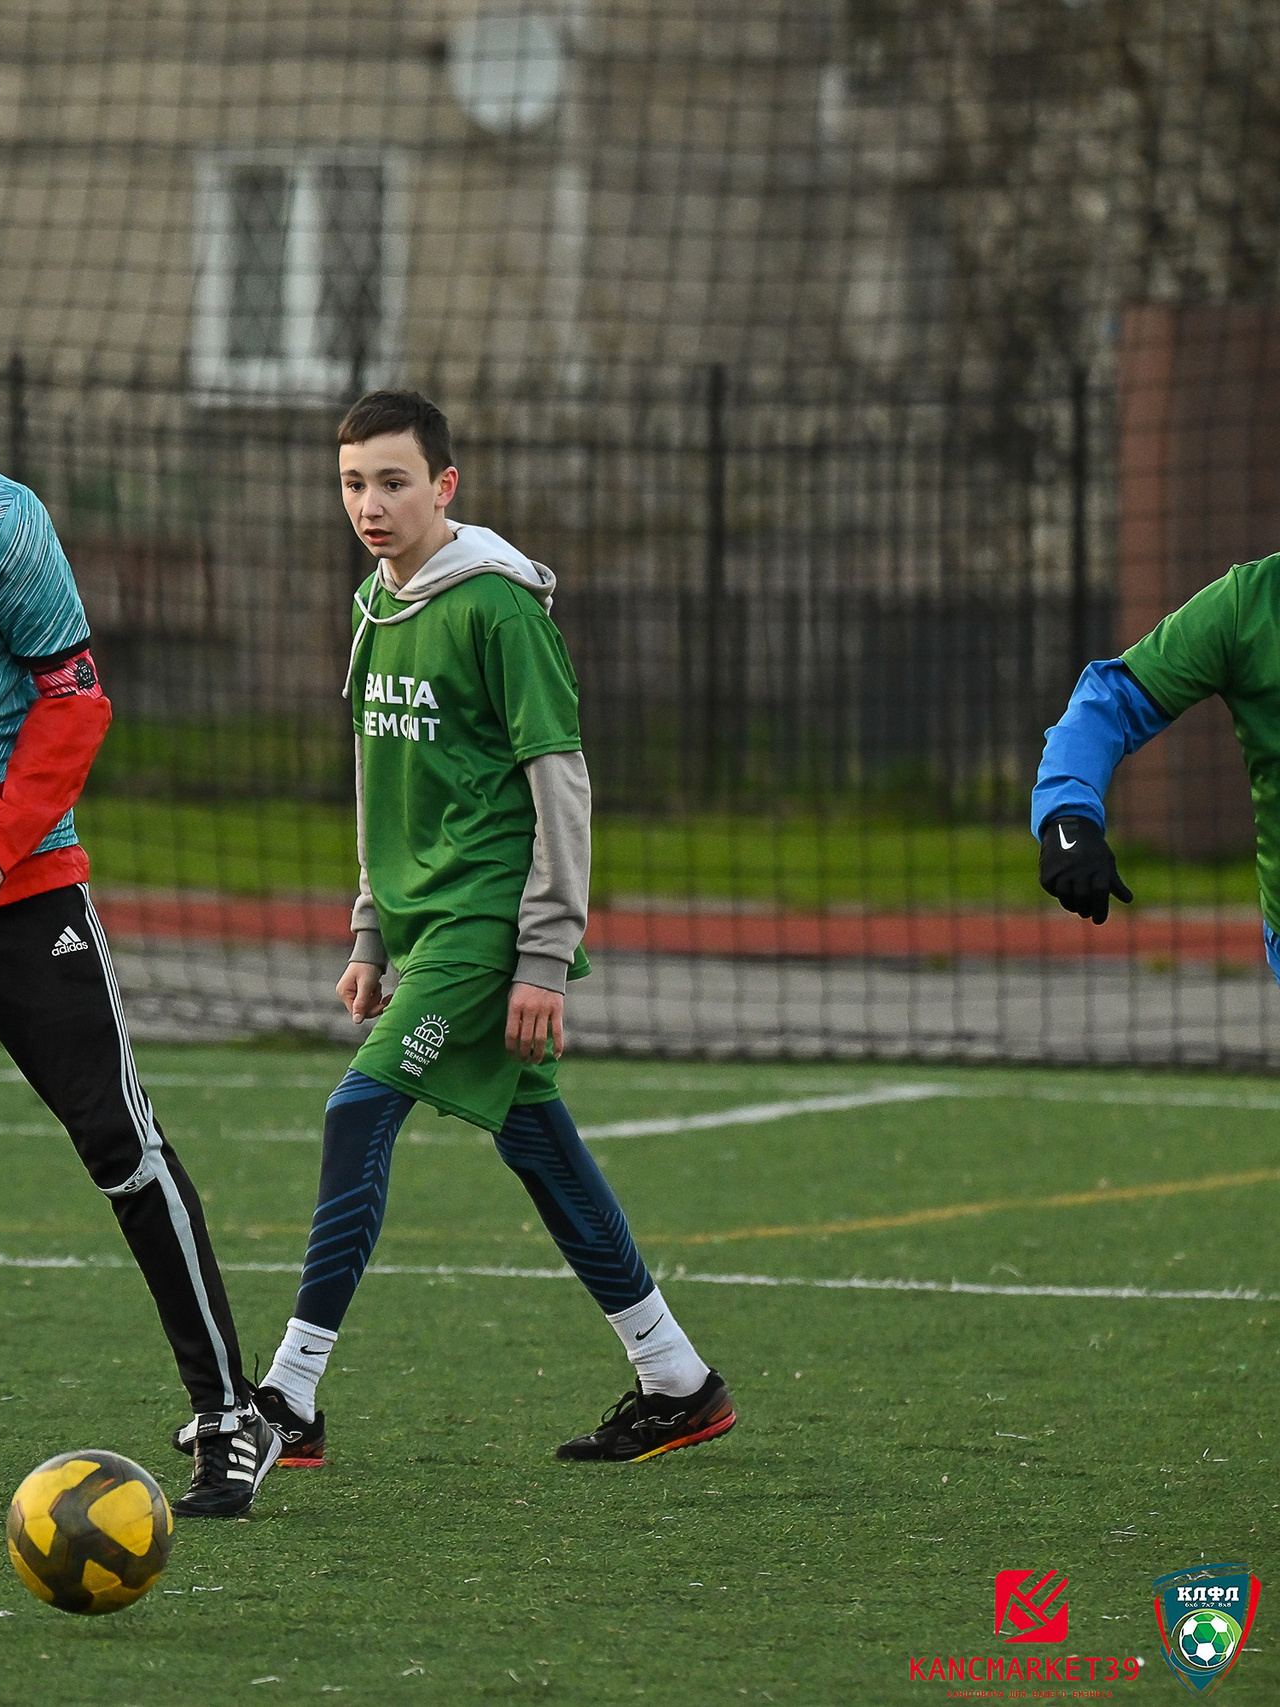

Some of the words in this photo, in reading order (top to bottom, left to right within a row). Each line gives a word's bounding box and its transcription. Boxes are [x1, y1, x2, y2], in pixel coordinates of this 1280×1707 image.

[364, 673, 439, 709] BALTA
[51, 941, 89, 957] adidas
[401, 1035, 439, 1060] BALTIA
[404, 1049, 430, 1066] REMONT
